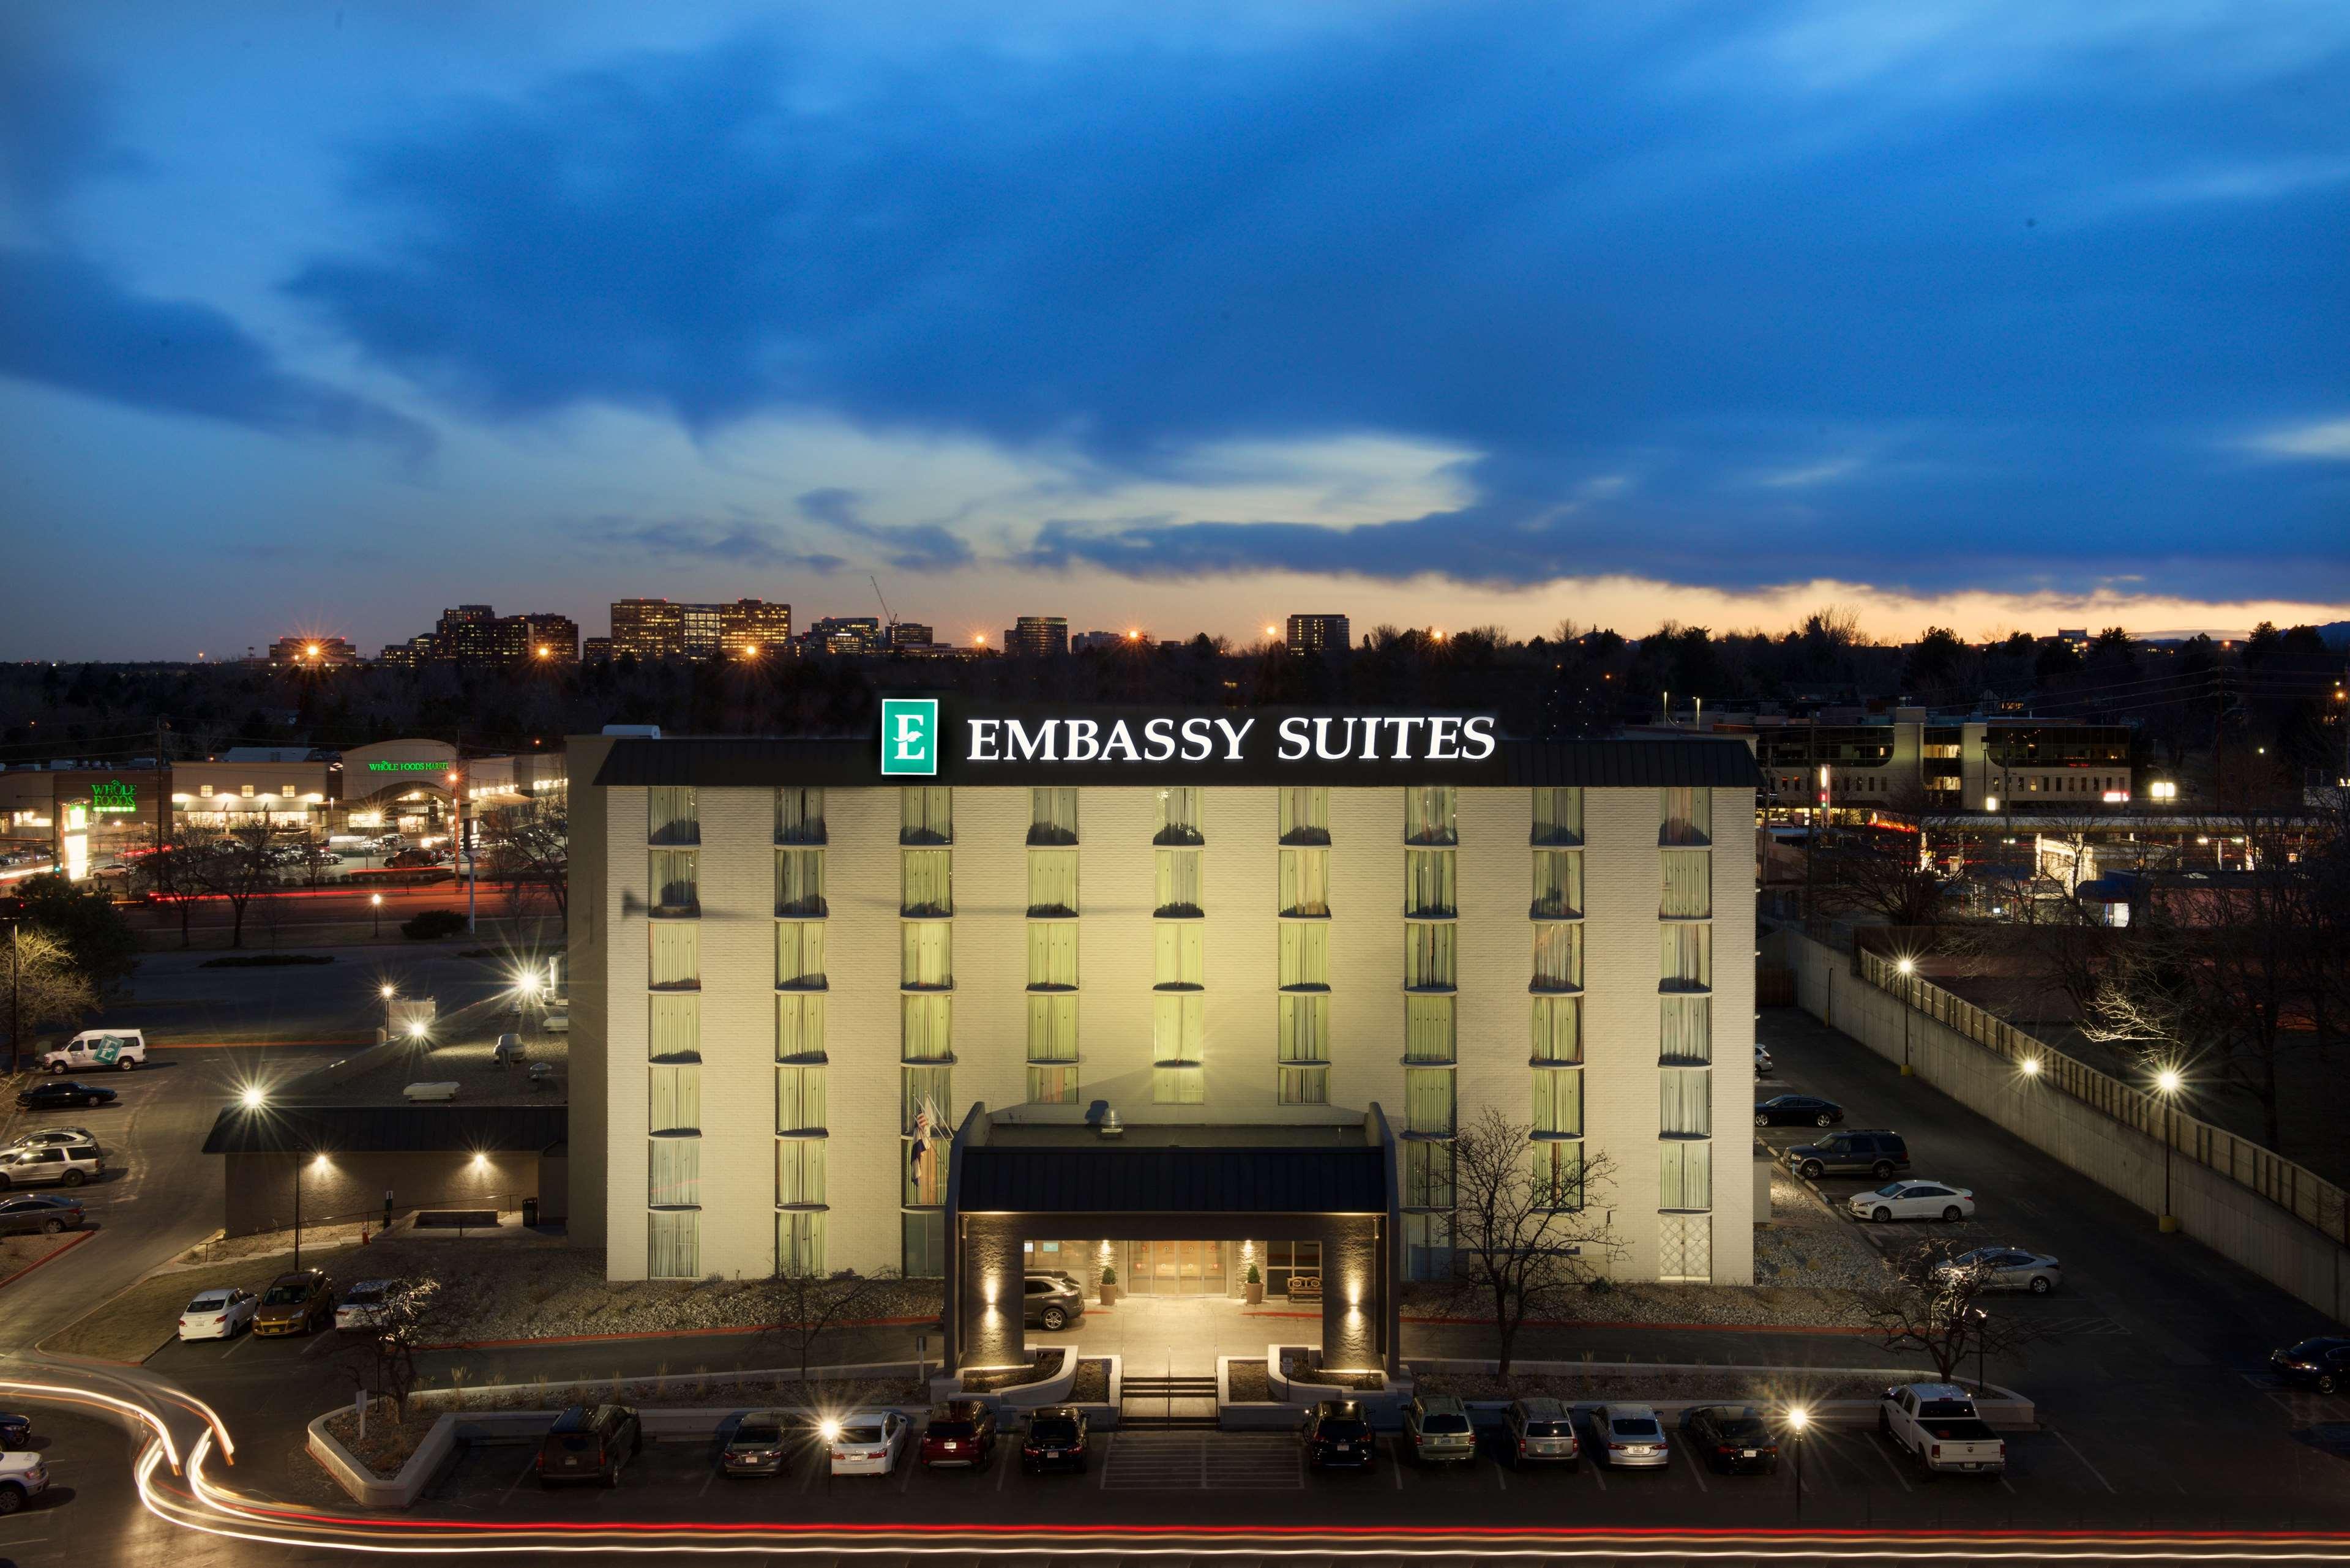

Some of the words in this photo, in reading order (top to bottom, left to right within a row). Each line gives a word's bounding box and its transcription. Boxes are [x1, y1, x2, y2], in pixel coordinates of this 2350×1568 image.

[894, 715, 924, 760] E
[967, 717, 1255, 761] EMBASSY
[1278, 716, 1495, 760] SUITES
[91, 784, 137, 795] WHOLE
[93, 796, 135, 806] FOODS
